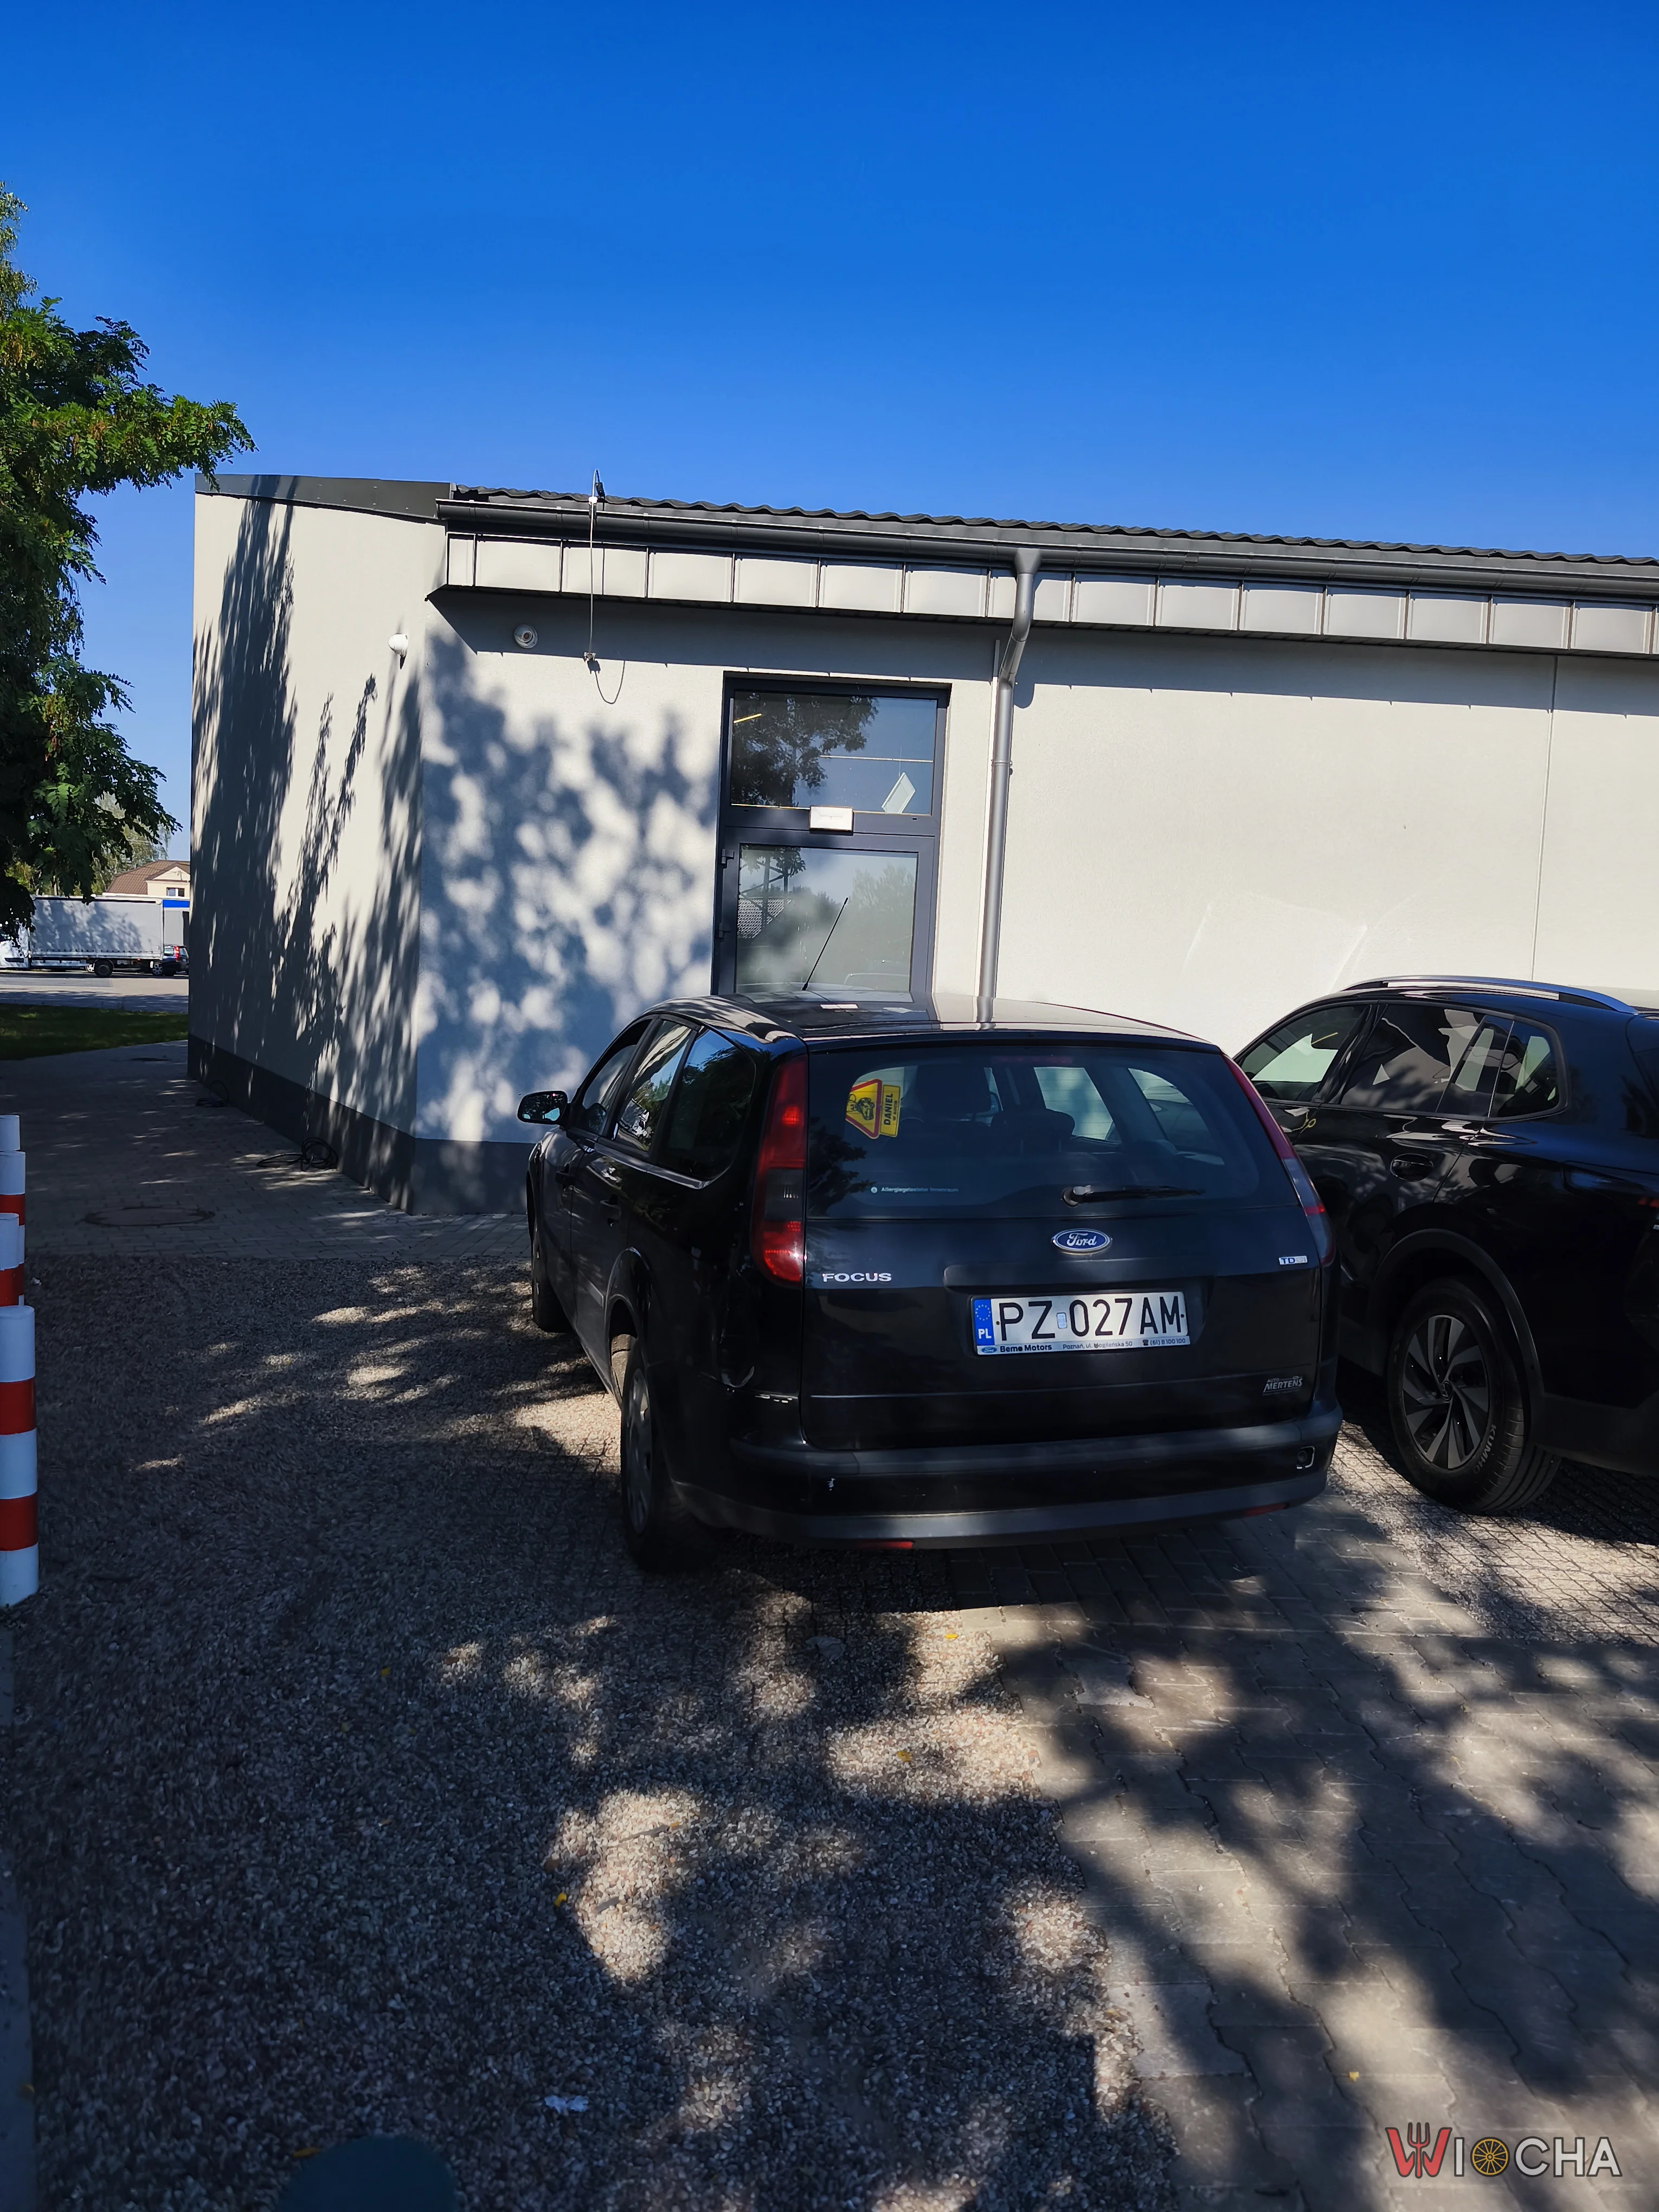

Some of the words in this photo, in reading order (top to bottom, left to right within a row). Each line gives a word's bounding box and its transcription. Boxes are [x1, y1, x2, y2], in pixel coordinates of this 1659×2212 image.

[884, 1093, 893, 1126] DANIEL
[1066, 1232, 1097, 1246] Ford
[822, 1272, 892, 1282] FOCUS
[999, 1300, 1056, 1341] PZ
[1069, 1295, 1182, 1338] 027AM
[978, 1328, 992, 1339] PL
[1263, 1378, 1303, 1393] MERTENS
[1474, 1424, 1496, 1474] KUMHO
